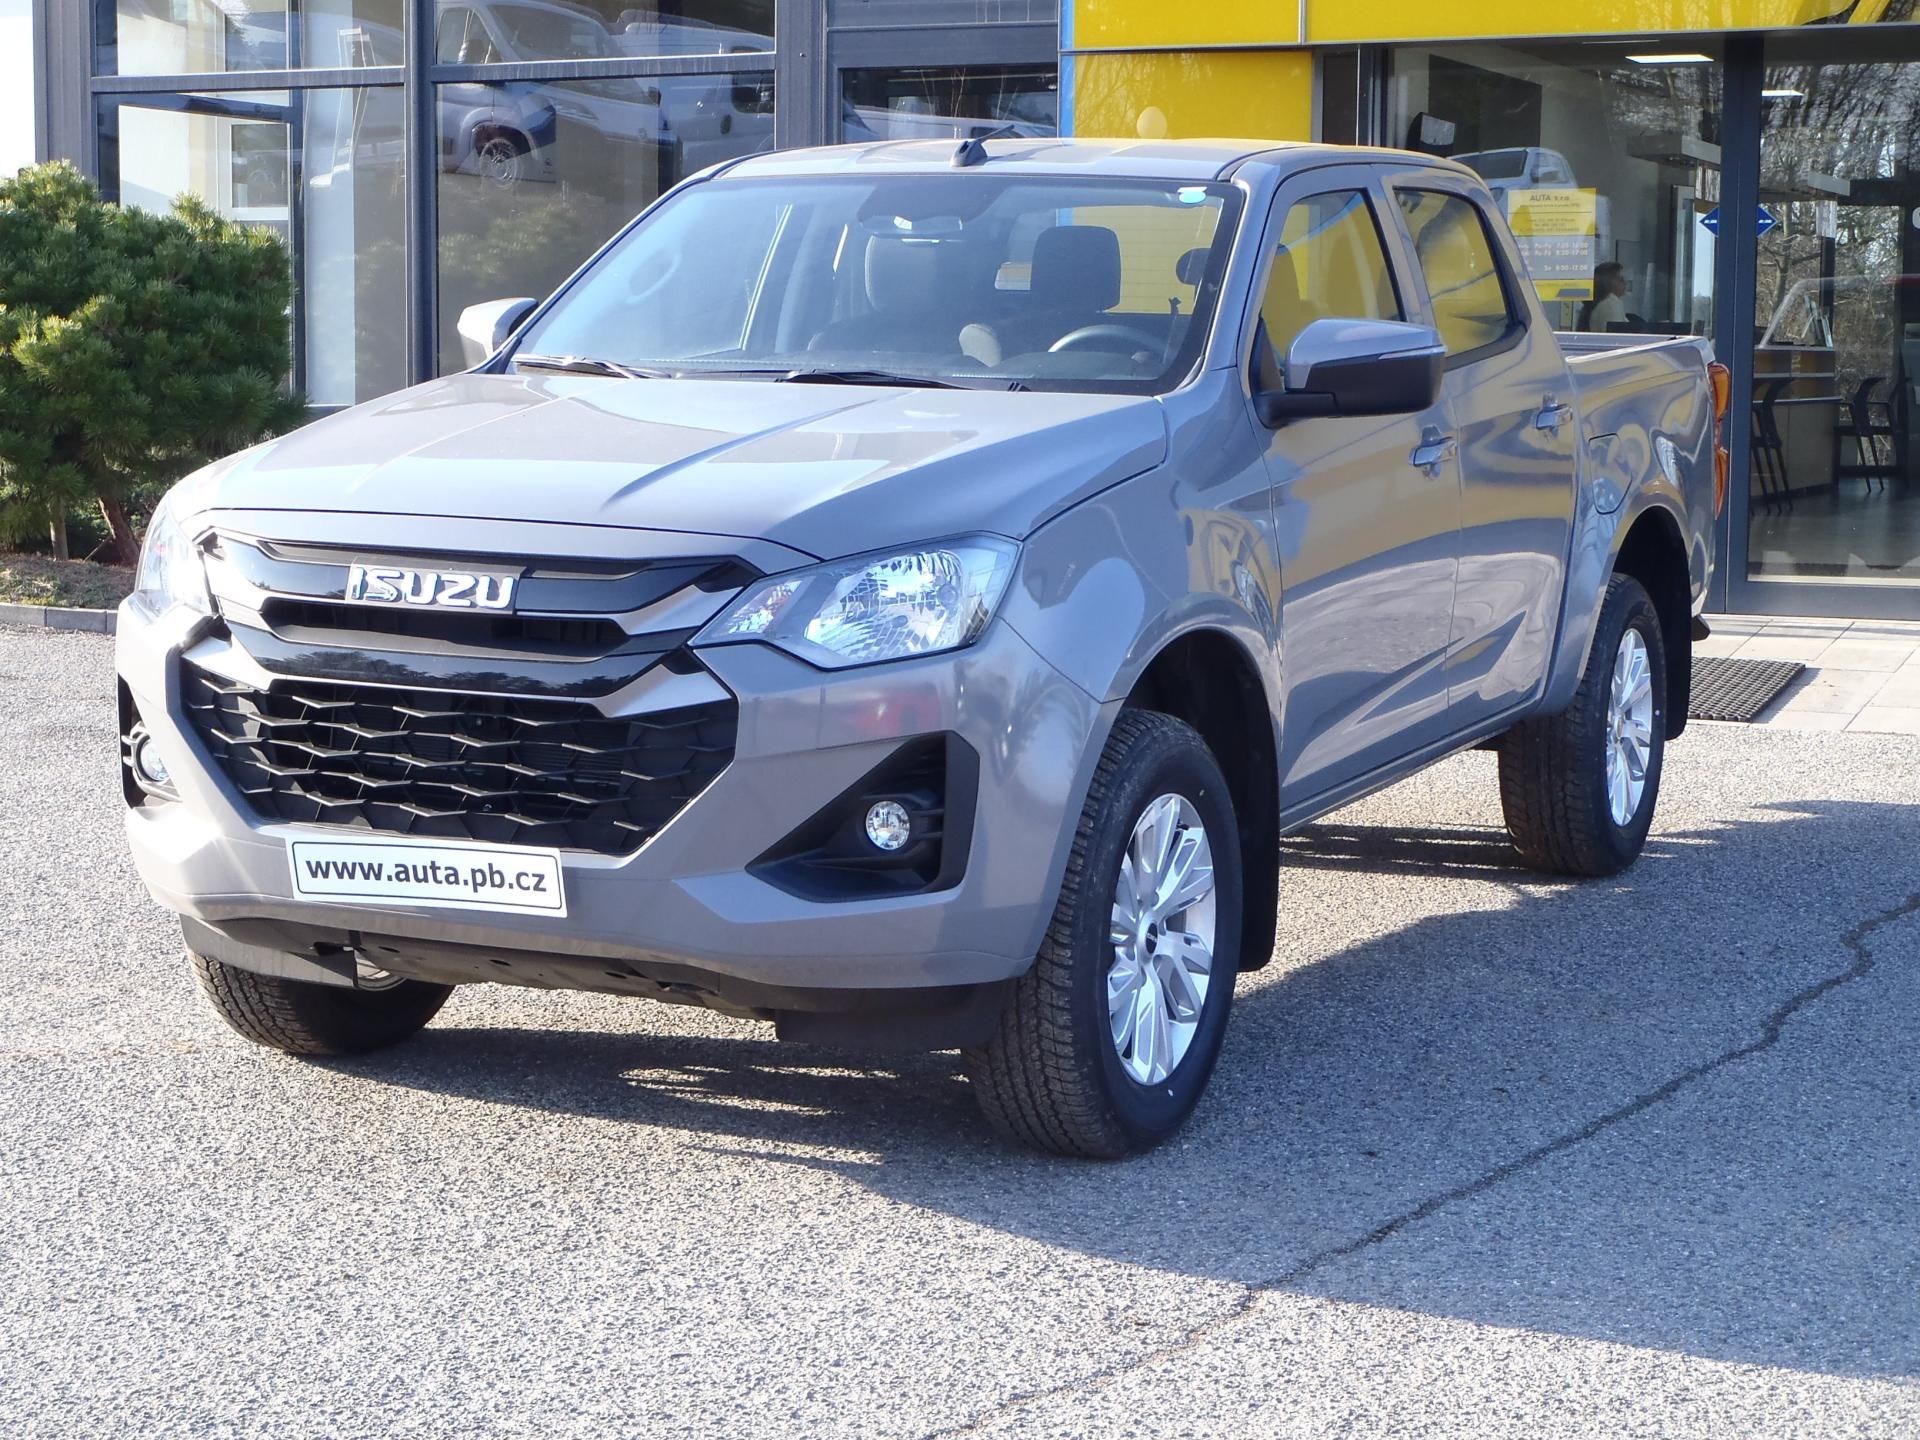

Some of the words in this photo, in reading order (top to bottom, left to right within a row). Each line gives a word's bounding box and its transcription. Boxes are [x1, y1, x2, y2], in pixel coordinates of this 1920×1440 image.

[1529, 194, 1551, 202] AUTA
[350, 565, 516, 610] ISUZU
[305, 857, 548, 893] www.auta.pb.cz
